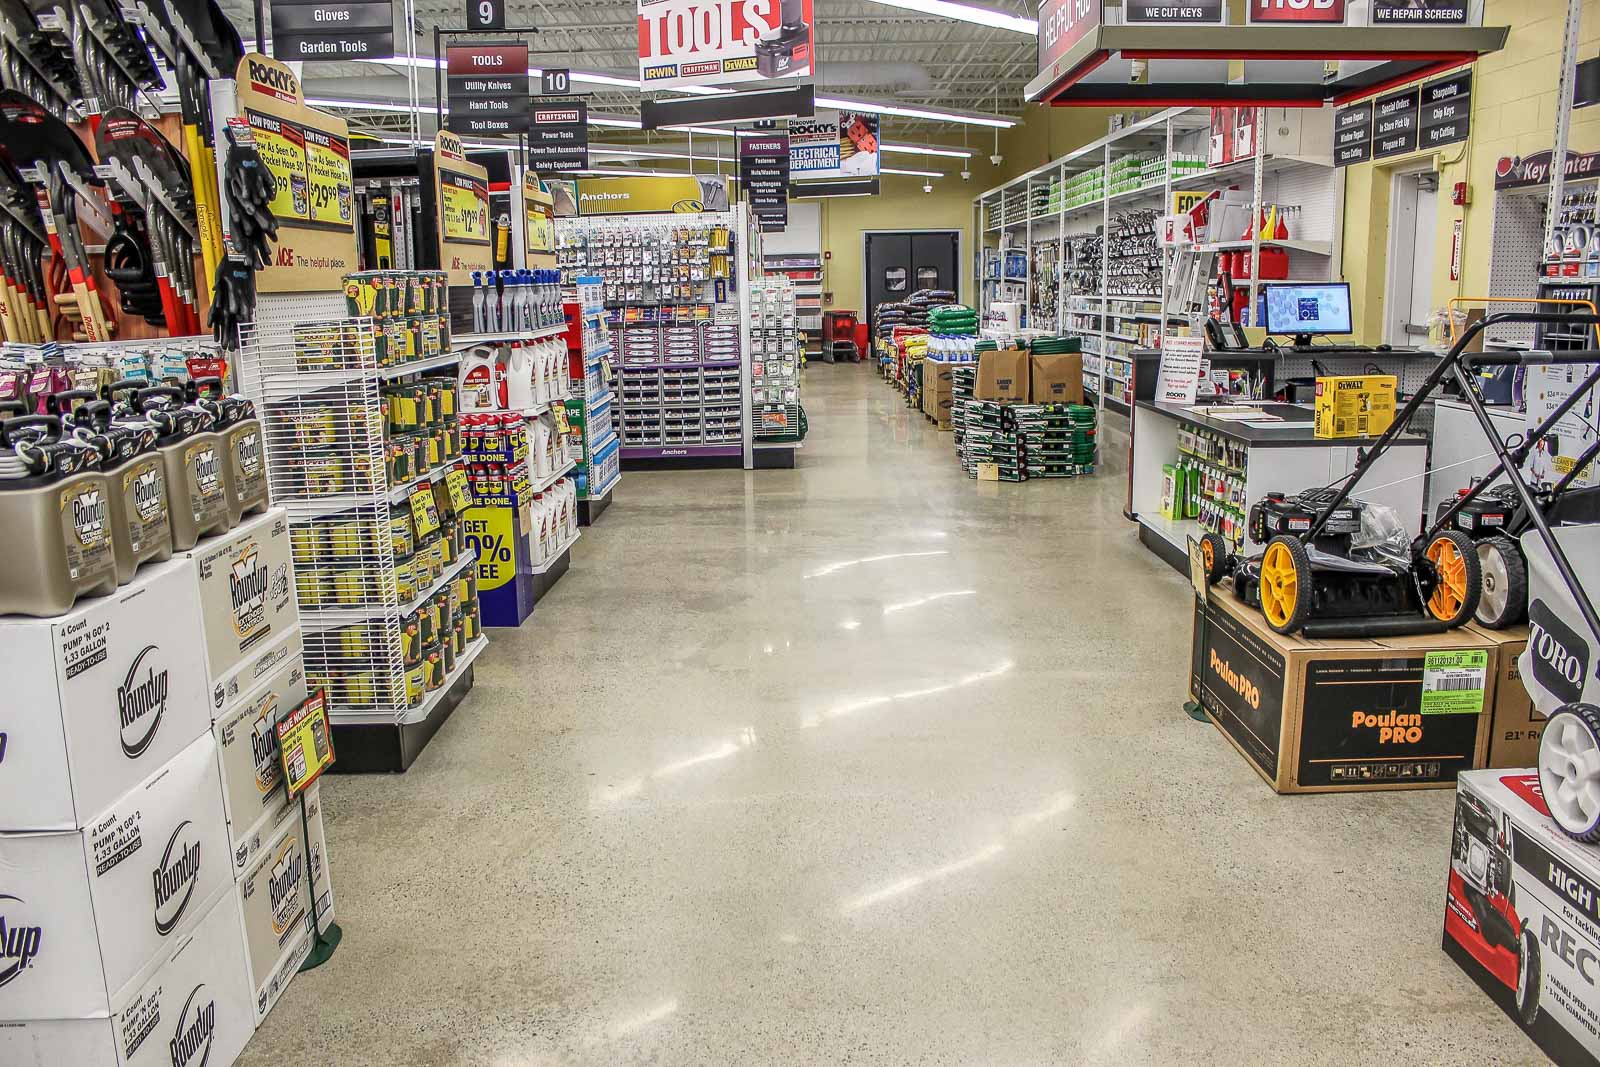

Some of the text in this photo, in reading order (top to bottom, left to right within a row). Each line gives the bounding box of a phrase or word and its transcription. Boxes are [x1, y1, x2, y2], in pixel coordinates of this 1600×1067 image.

[314, 10, 350, 21] Gloves
[480, 2, 493, 24] 9
[1146, 8, 1202, 17] WE CUT KEYS
[1377, 9, 1463, 19] WE REPAIR SCREENS
[639, 0, 781, 57] TOOLS
[300, 41, 367, 53] Garden Tools
[472, 56, 502, 66] TOOLS
[645, 67, 676, 80] IRWIN
[683, 65, 719, 74] CRAFTSMAN
[465, 81, 512, 92] Utility Knives
[546, 73, 566, 91] 10
[1432, 83, 1457, 100] Sharpening
[470, 100, 509, 110] Hand Tools
[248, 114, 281, 133] LOW PRICE
[471, 120, 509, 130] Tool Boxes
[789, 120, 816, 129] Discover
[304, 129, 330, 148] LOW PRICE
[749, 143, 781, 151] FASTENERS
[267, 145, 275, 154] As
[276, 148, 289, 159] Seen
[289, 149, 298, 159] On
[789, 148, 839, 160] ELECTRICAL
[789, 159, 839, 174] DEPARTMENT
[1524, 162, 1547, 183] Key
[580, 192, 630, 202] Anchors
[297, 256, 308, 268] The
[310, 256, 332, 269] helpful
[480, 454, 508, 463] DONE.
[484, 497, 512, 506] DONE.
[464, 520, 488, 533] GET
[230, 564, 268, 611] Roundup
[61, 618, 87, 638] 4 Count
[63, 636, 83, 653] PUMP
[64, 636, 107, 665] 1.33 GALLON
[1529, 619, 1581, 684] TORO
[1211, 648, 1261, 710] Poulan PRO
[117, 668, 169, 730] Roundup
[280, 704, 310, 736] SAVE NOW!
[1352, 710, 1422, 729] Poulan
[1379, 727, 1423, 744] PRO
[92, 814, 117, 837] 4 Count
[93, 834, 115, 853] PUMP
[95, 825, 141, 863] 1.33 GALLON
[153, 841, 201, 911] Roundup
[1548, 862, 1592, 911] HIGH
[1563, 905, 1574, 921] For
[127, 995, 143, 1015] Count
[1572, 995, 1587, 1012] SPEED
[123, 1016, 141, 1037] PUMP
[124, 1003, 160, 1046] 1.33 GALLON
[1565, 1003, 1597, 1036] GUARANTEED
